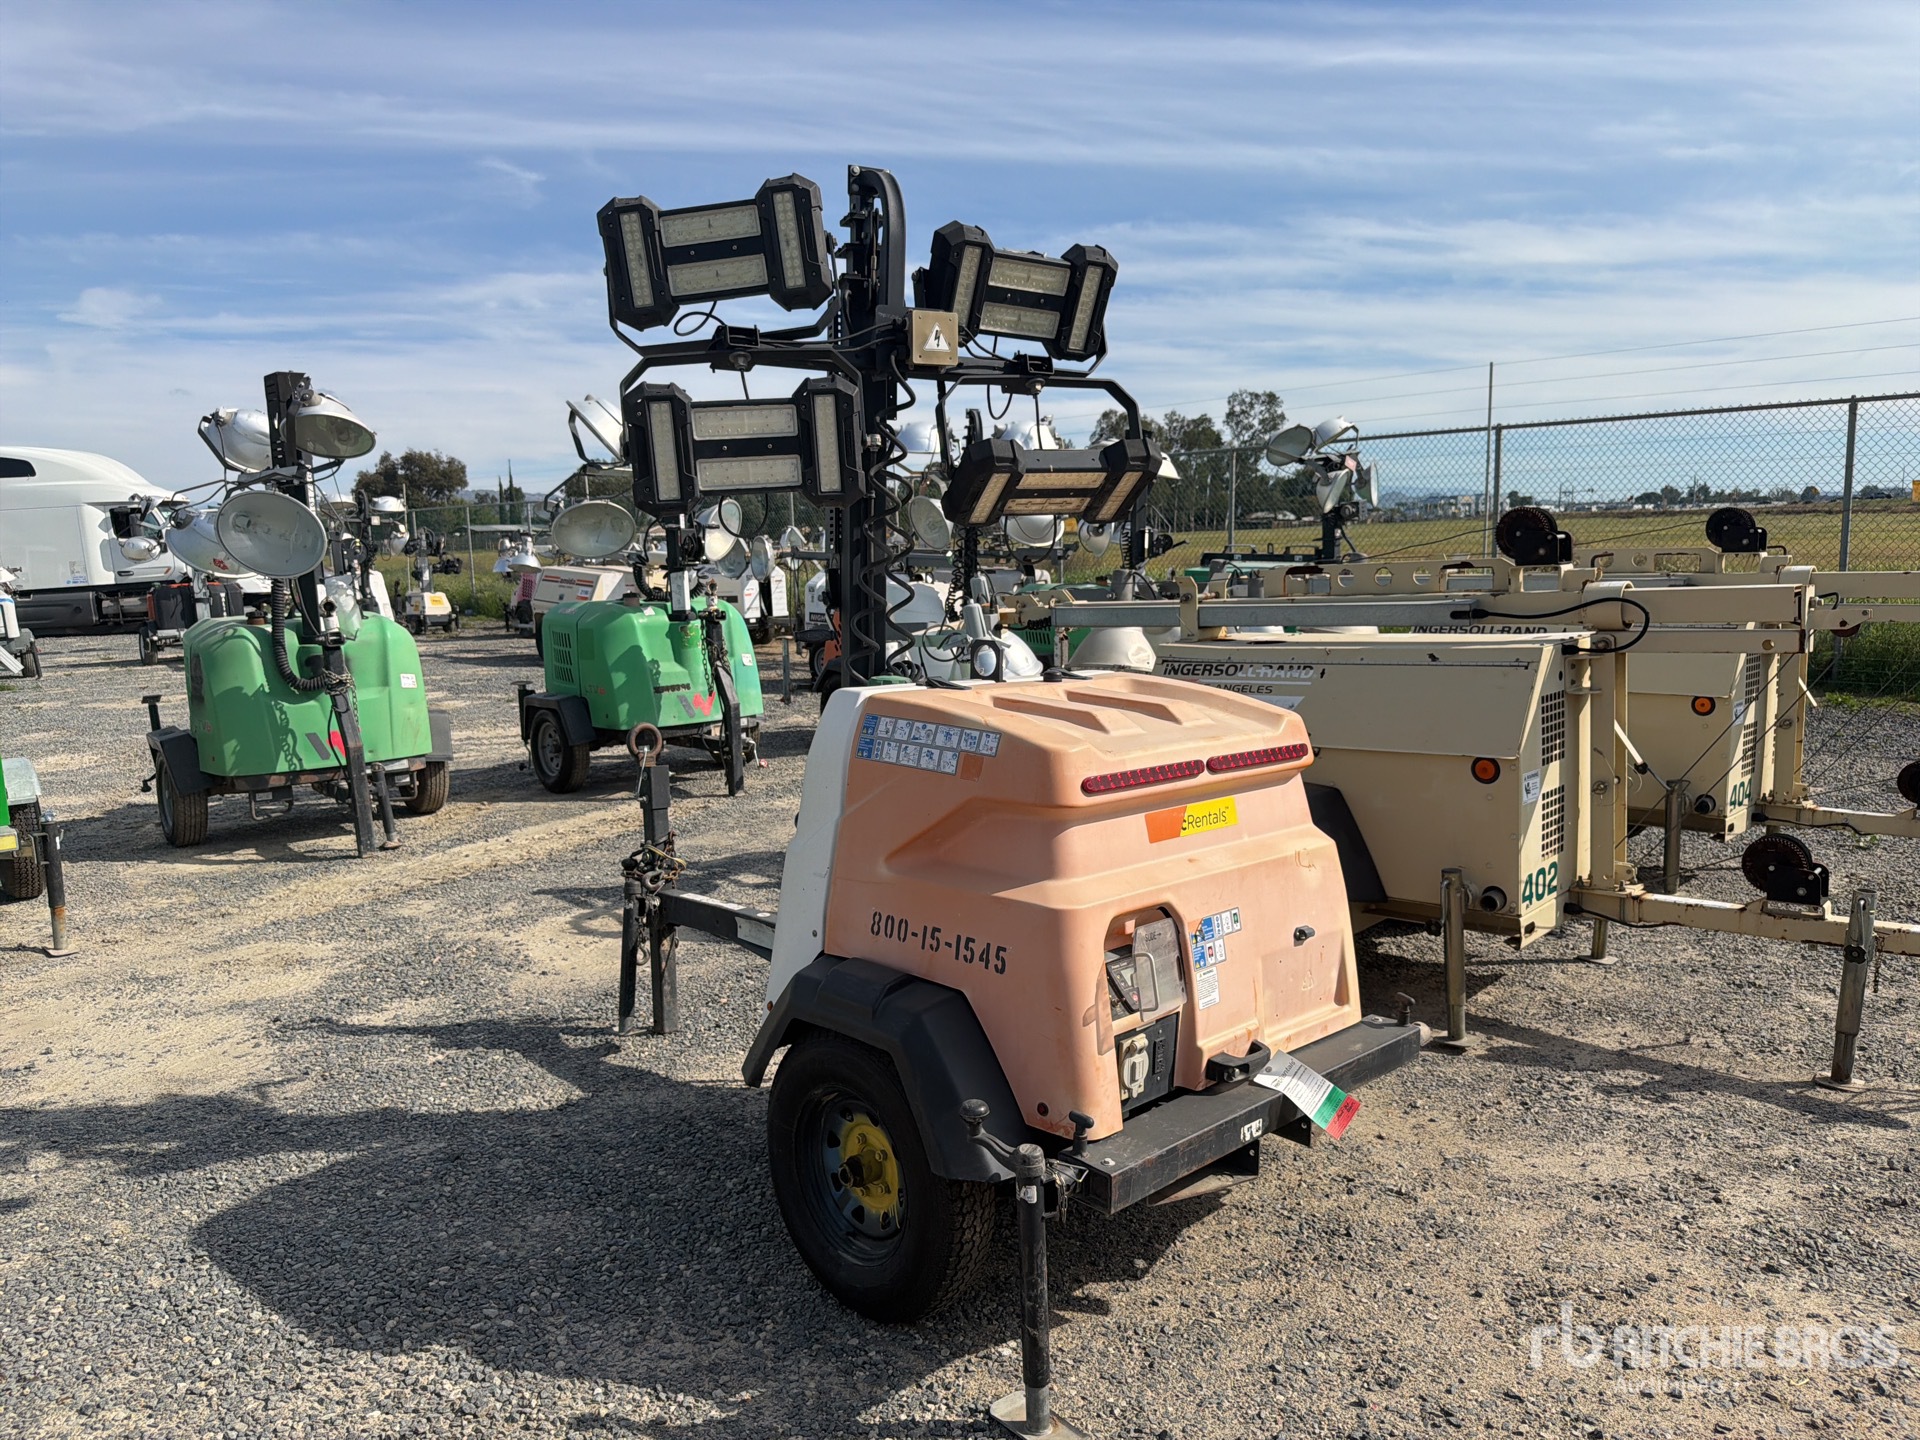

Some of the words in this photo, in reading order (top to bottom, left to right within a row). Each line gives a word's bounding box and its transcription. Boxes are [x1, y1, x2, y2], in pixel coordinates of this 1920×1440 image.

[1163, 663, 1315, 679] INGERSOLL-RAND
[1729, 778, 1752, 809] 404
[1522, 861, 1558, 906] 402
[870, 911, 1007, 975] 800-15-1545
